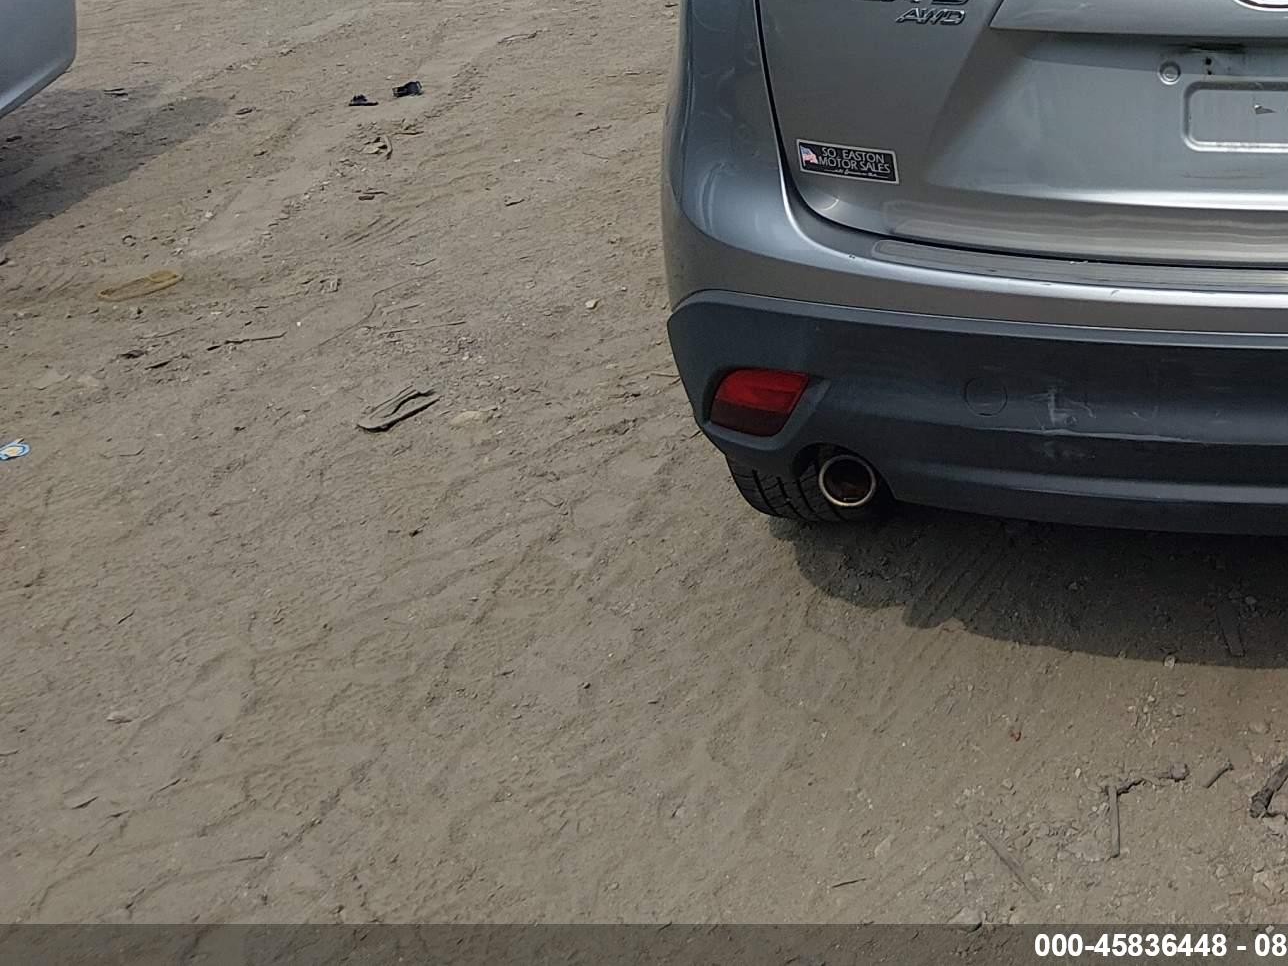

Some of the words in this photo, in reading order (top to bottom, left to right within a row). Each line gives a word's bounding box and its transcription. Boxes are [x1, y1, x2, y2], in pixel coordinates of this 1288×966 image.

[895, 7, 966, 26] AWD
[818, 155, 859, 170] MOTOR
[860, 161, 891, 174] SALES
[842, 149, 885, 164] EASTON
